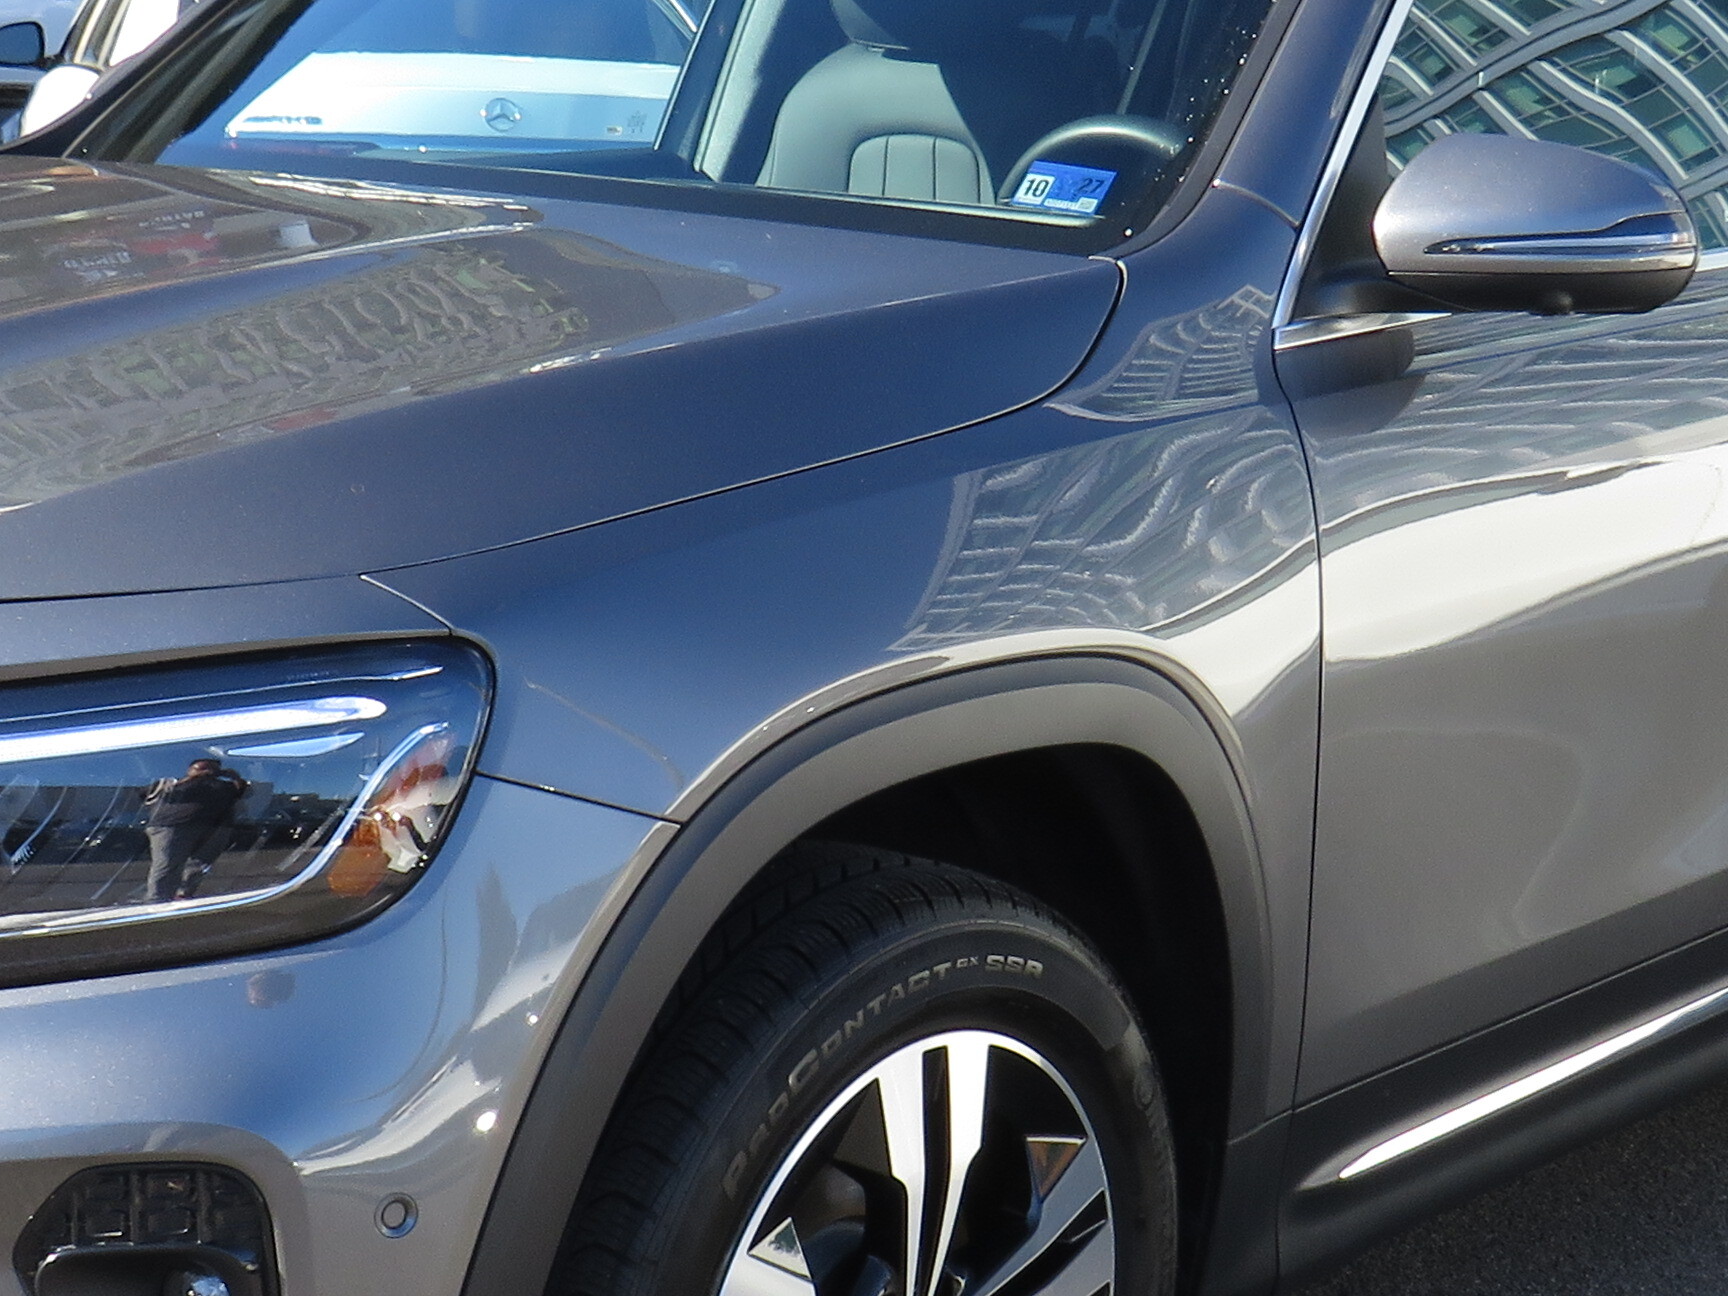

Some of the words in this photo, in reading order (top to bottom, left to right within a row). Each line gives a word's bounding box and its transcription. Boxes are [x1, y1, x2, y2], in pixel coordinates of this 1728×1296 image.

[1024, 178, 1050, 198] 10
[1078, 177, 1105, 195] 27
[985, 954, 1044, 977] SSR
